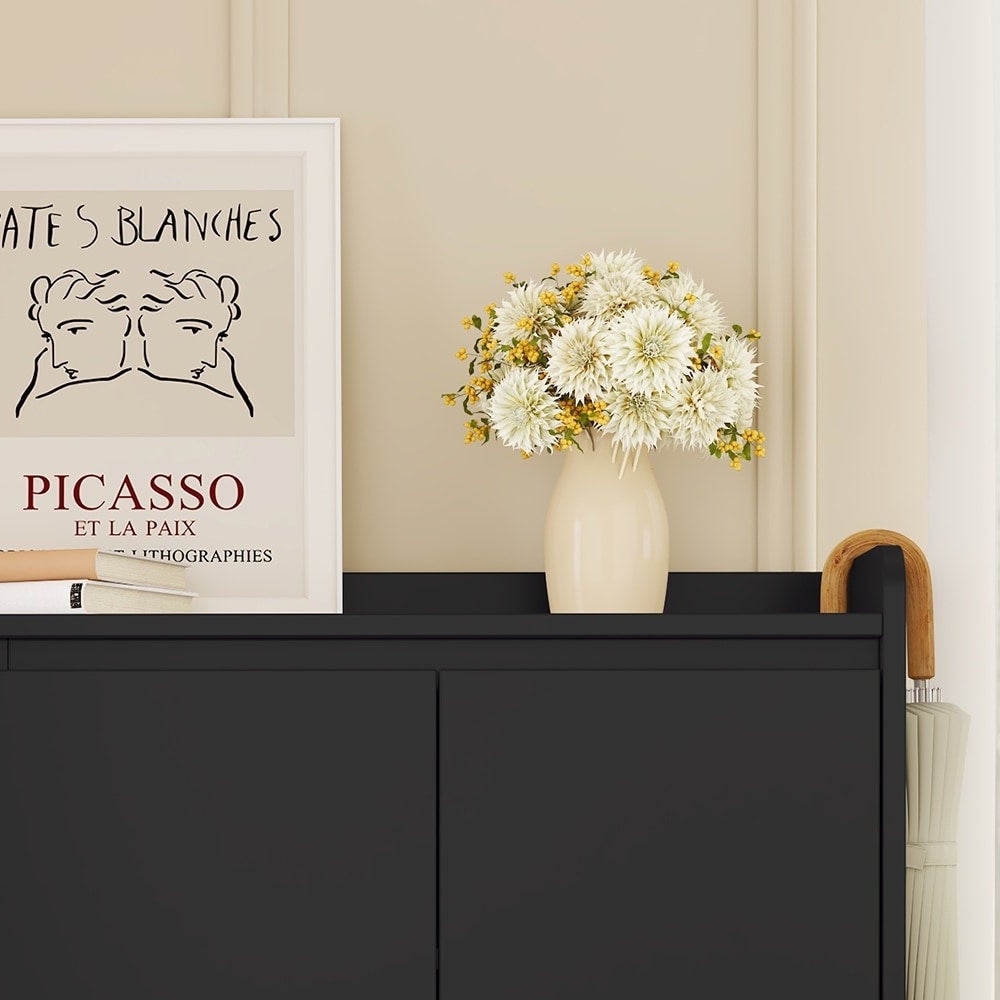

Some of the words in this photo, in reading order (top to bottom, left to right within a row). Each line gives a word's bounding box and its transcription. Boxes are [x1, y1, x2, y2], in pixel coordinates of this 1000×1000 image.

[111, 204, 282, 246] BLANCHES
[22, 473, 245, 511] PICASSO
[74, 520, 101, 537] ET
[109, 520, 138, 537] LA
[146, 520, 197, 537] PAIX
